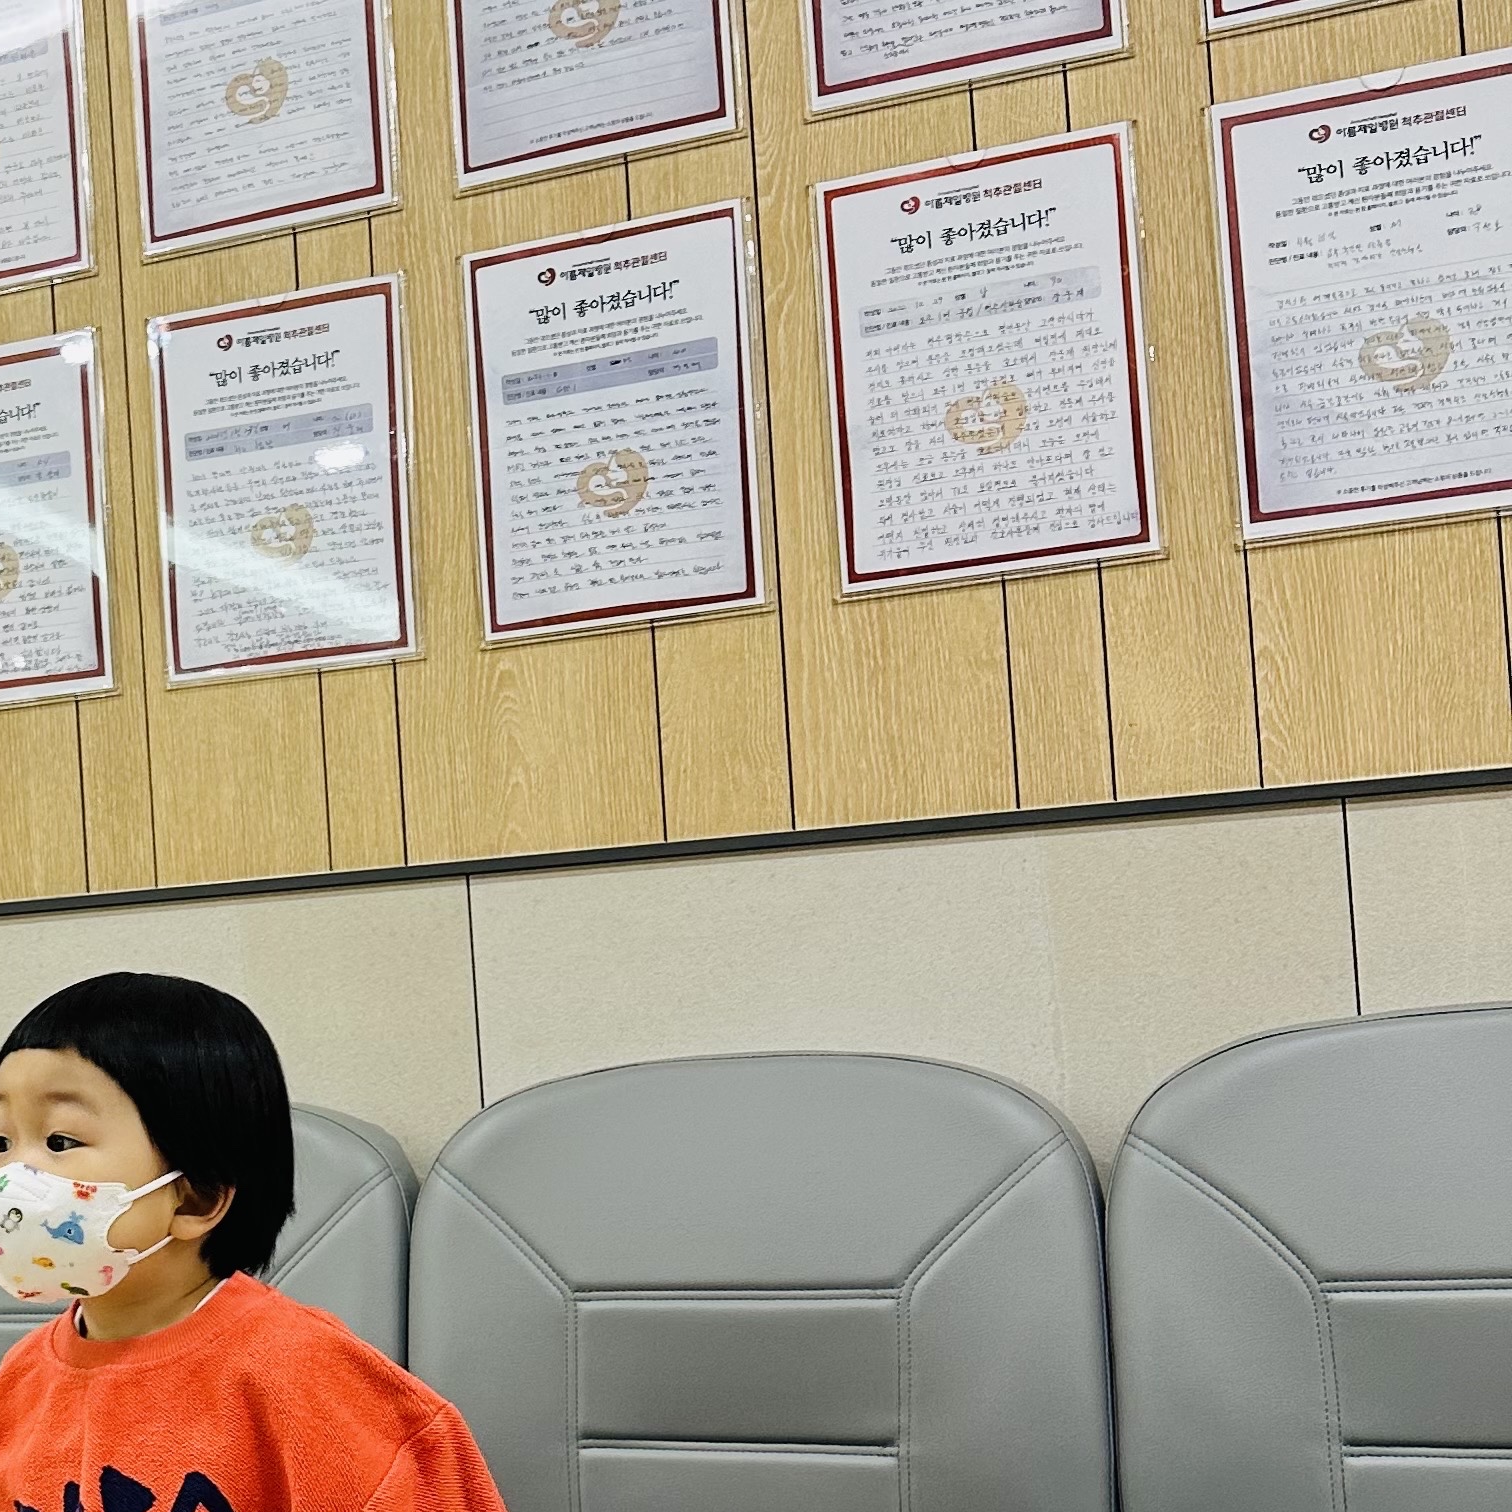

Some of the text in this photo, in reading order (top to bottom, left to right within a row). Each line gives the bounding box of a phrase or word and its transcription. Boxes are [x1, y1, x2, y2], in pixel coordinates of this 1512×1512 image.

[1298, 158, 1343, 186] “많이
[890, 230, 932, 256] “많이
[529, 302, 566, 326] “많이
